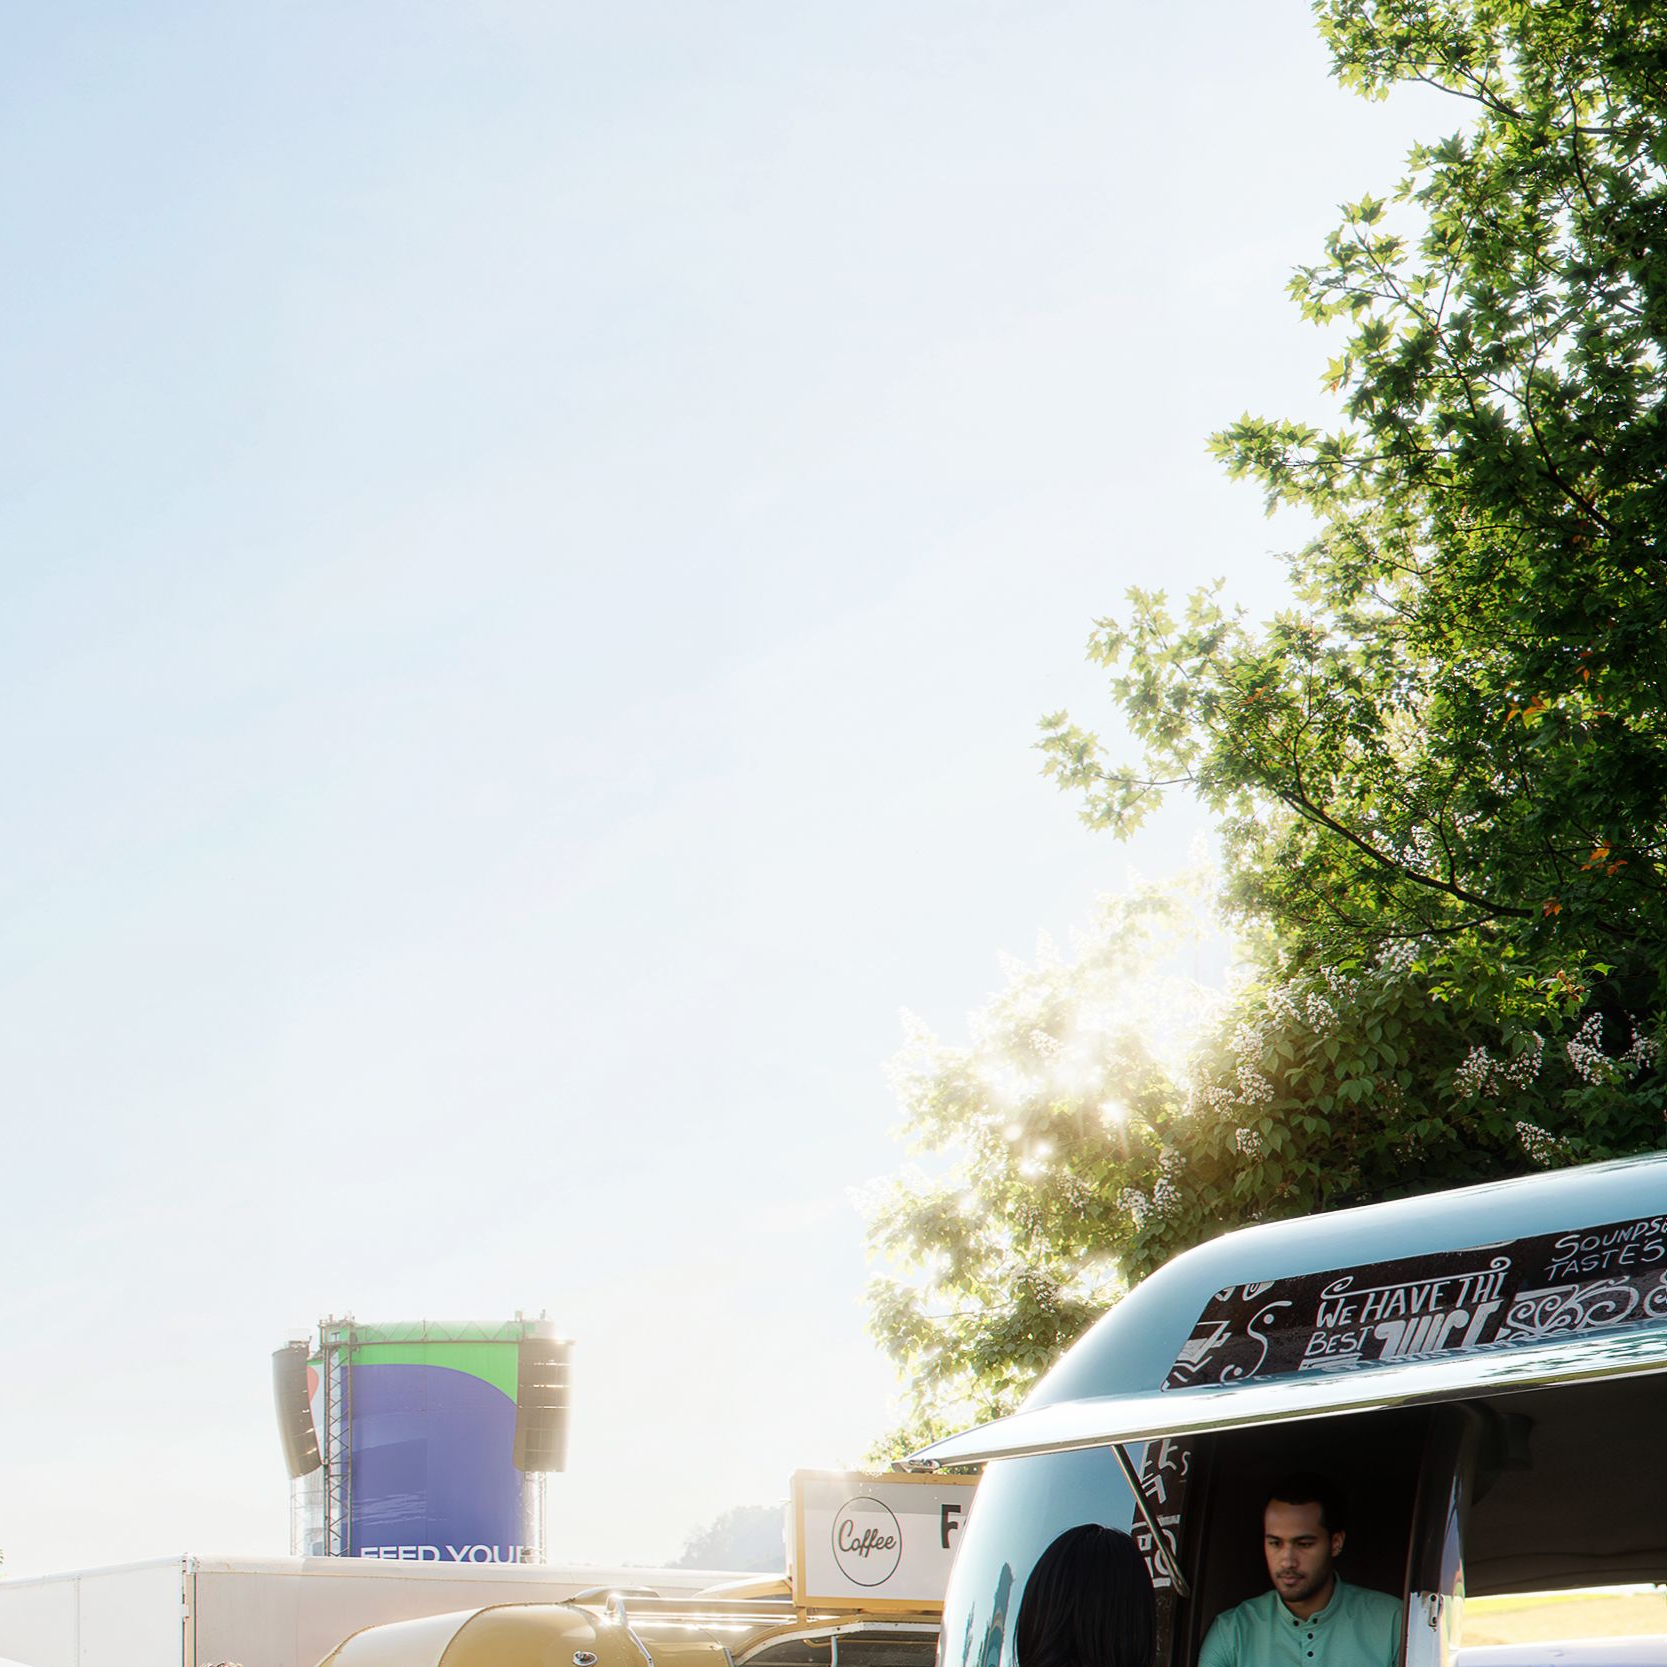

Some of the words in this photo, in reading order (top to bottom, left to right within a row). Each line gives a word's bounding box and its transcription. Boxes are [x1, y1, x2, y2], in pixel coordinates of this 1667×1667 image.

[1317, 1299, 1362, 1329] WE
[1361, 1281, 1445, 1323] HAVE
[1304, 1325, 1375, 1357] BEST
[838, 1520, 897, 1557] Coffee
[940, 1504, 965, 1549] F
[361, 1545, 441, 1561] FEED
